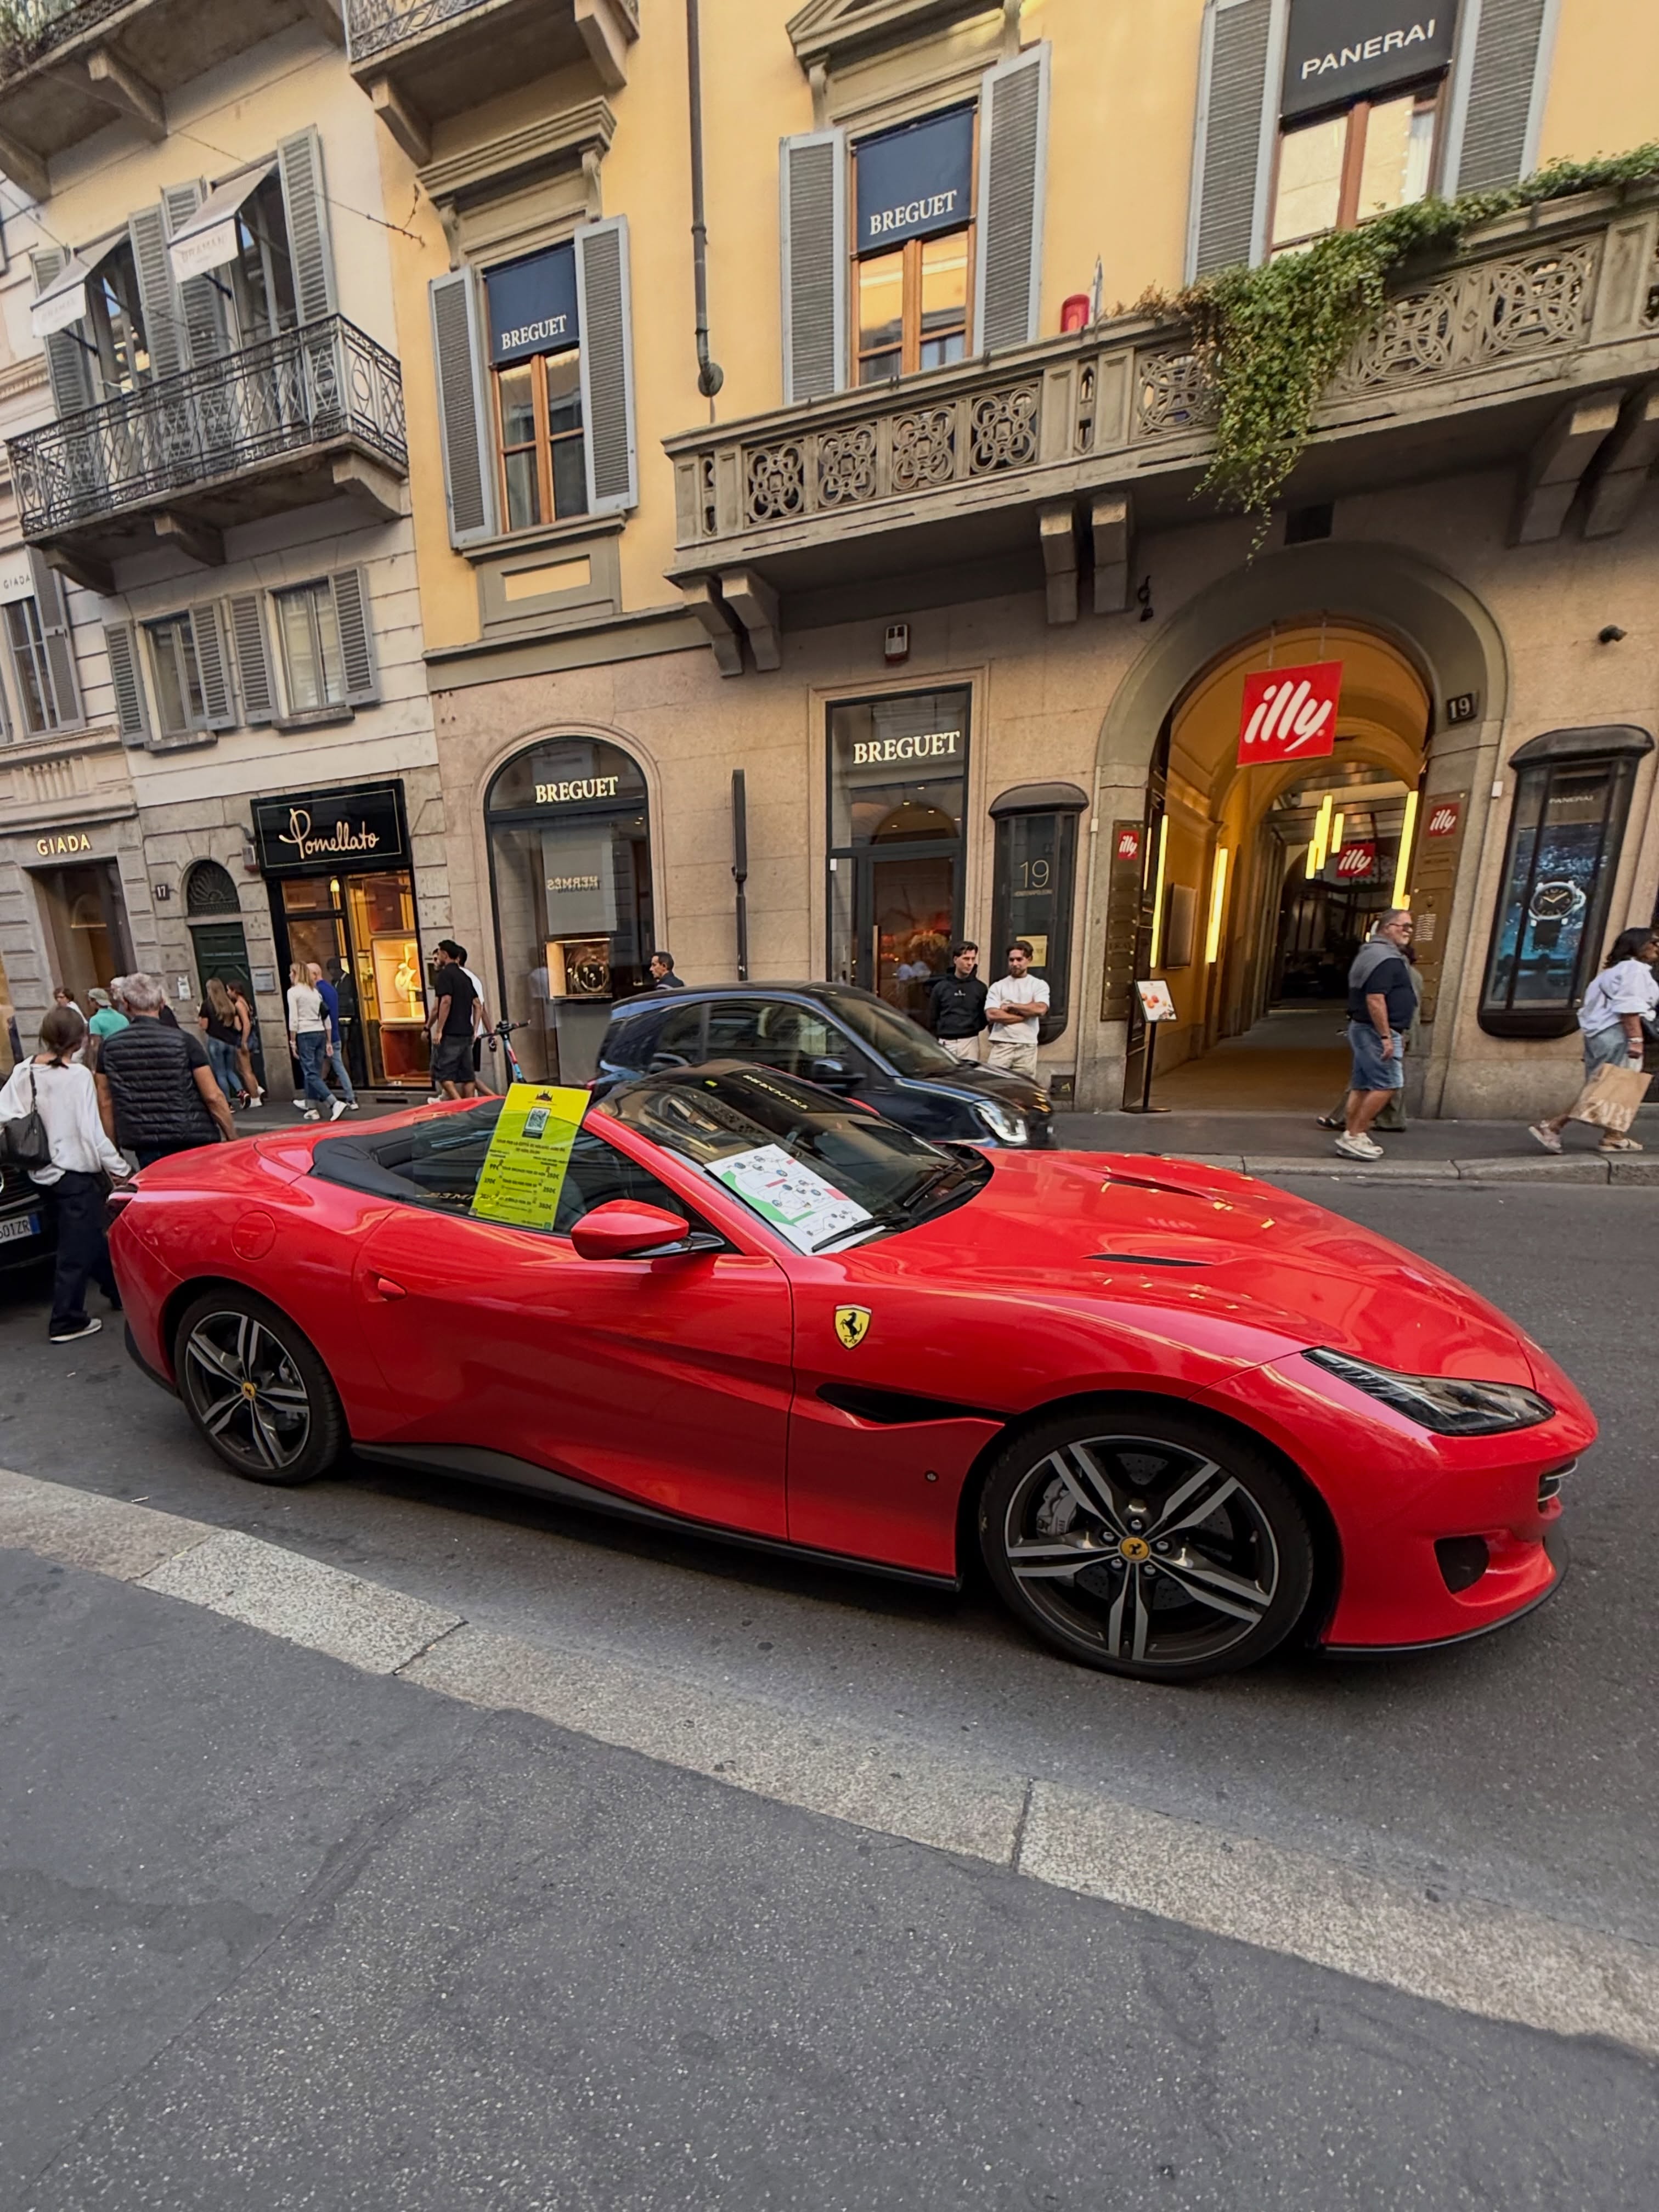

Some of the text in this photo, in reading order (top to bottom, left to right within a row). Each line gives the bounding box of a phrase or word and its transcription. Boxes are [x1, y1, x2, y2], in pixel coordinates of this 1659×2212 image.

[1301, 19, 1436, 80] PANERAI
[869, 189, 957, 236] BREGUET
[501, 314, 567, 350] BREGUET
[3, 573, 30, 589] GIADA
[1244, 680, 1333, 753] illy
[1449, 697, 1471, 719] 19
[853, 730, 960, 764] BREGUET
[534, 775, 619, 804] BREGUET
[278, 808, 380, 860] Pomellato
[1429, 809, 1457, 834] illy
[37, 833, 91, 856] GIADA
[1119, 835, 1138, 857] illy
[1020, 859, 1049, 888] 19
[1338, 849, 1372, 874] illy
[157, 885, 166, 898] 17
